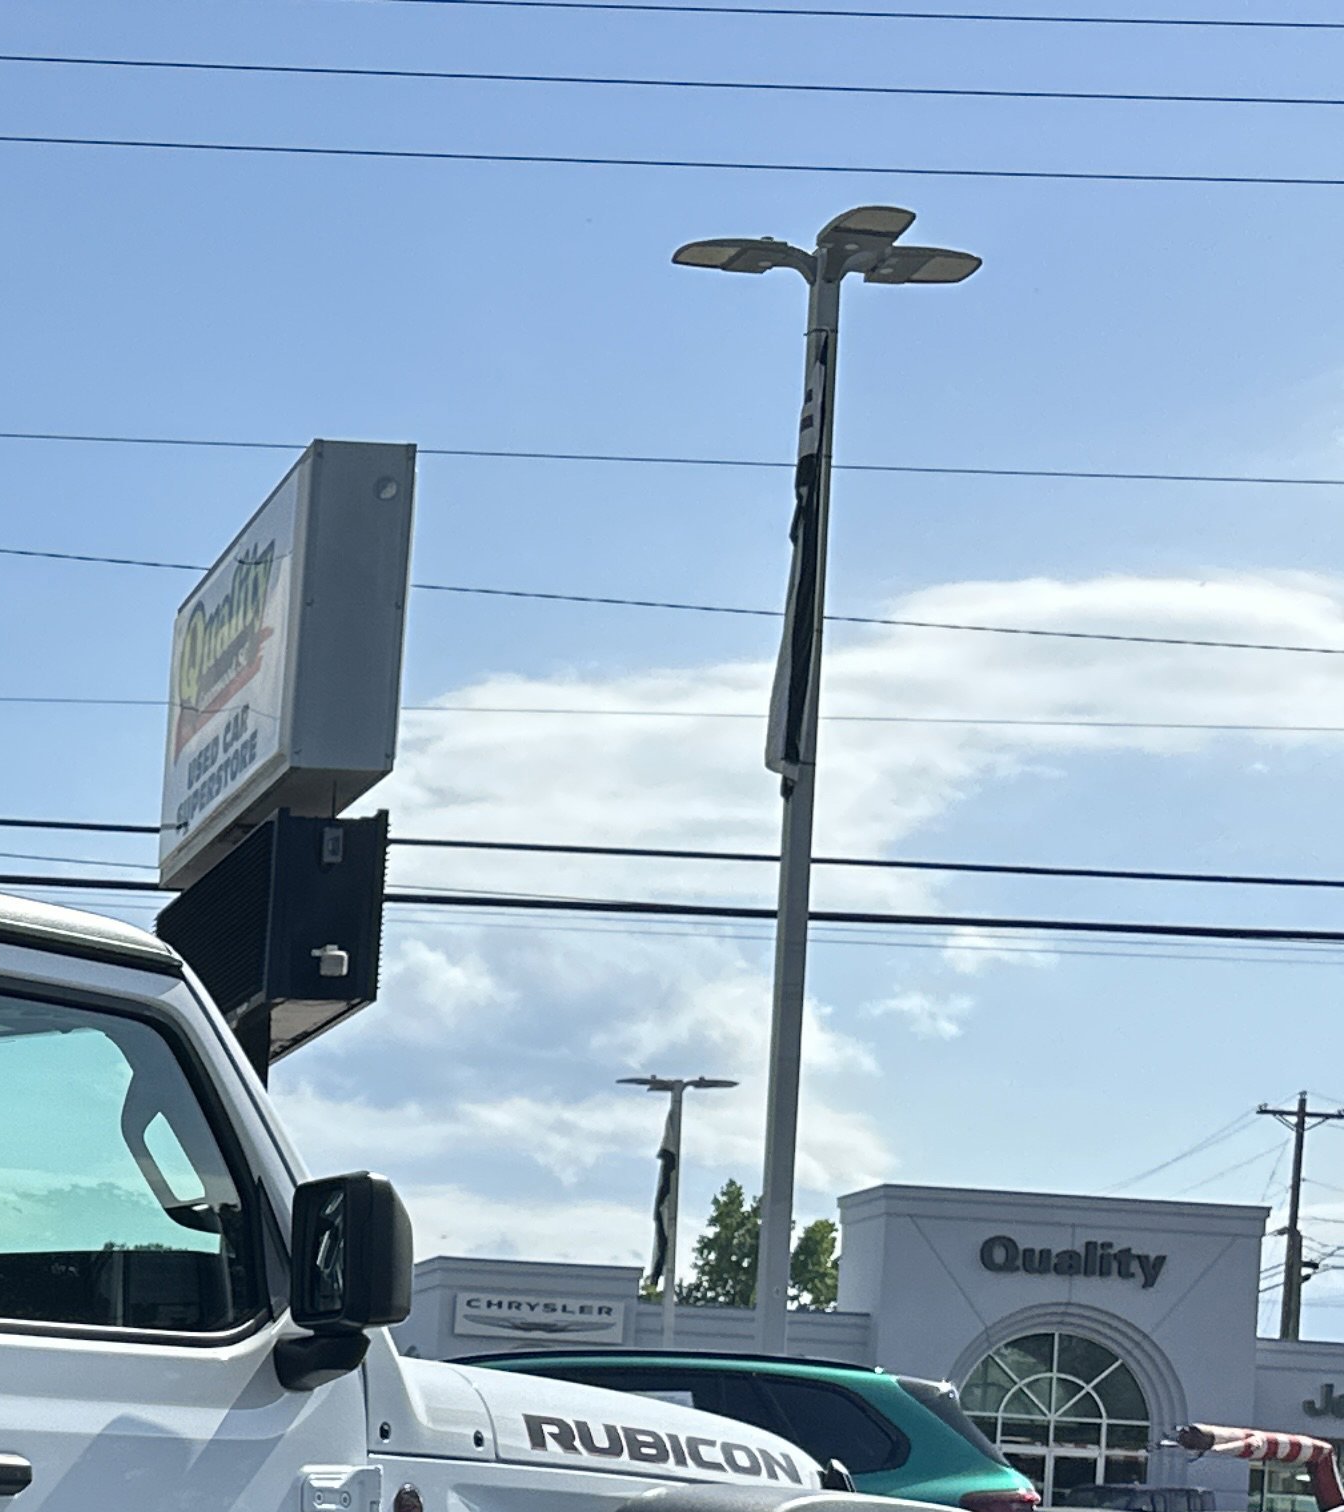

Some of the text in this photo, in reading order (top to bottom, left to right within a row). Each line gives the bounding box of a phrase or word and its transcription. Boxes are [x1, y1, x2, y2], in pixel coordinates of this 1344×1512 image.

[179, 537, 275, 707] Quality
[176, 728, 258, 836] SUPERSTORE
[187, 734, 220, 790] USED
[222, 704, 250, 754] CAR
[979, 1235, 1166, 1289] Quality
[466, 1298, 613, 1317] CHRYSLER
[521, 1413, 803, 1485] RUBICON
